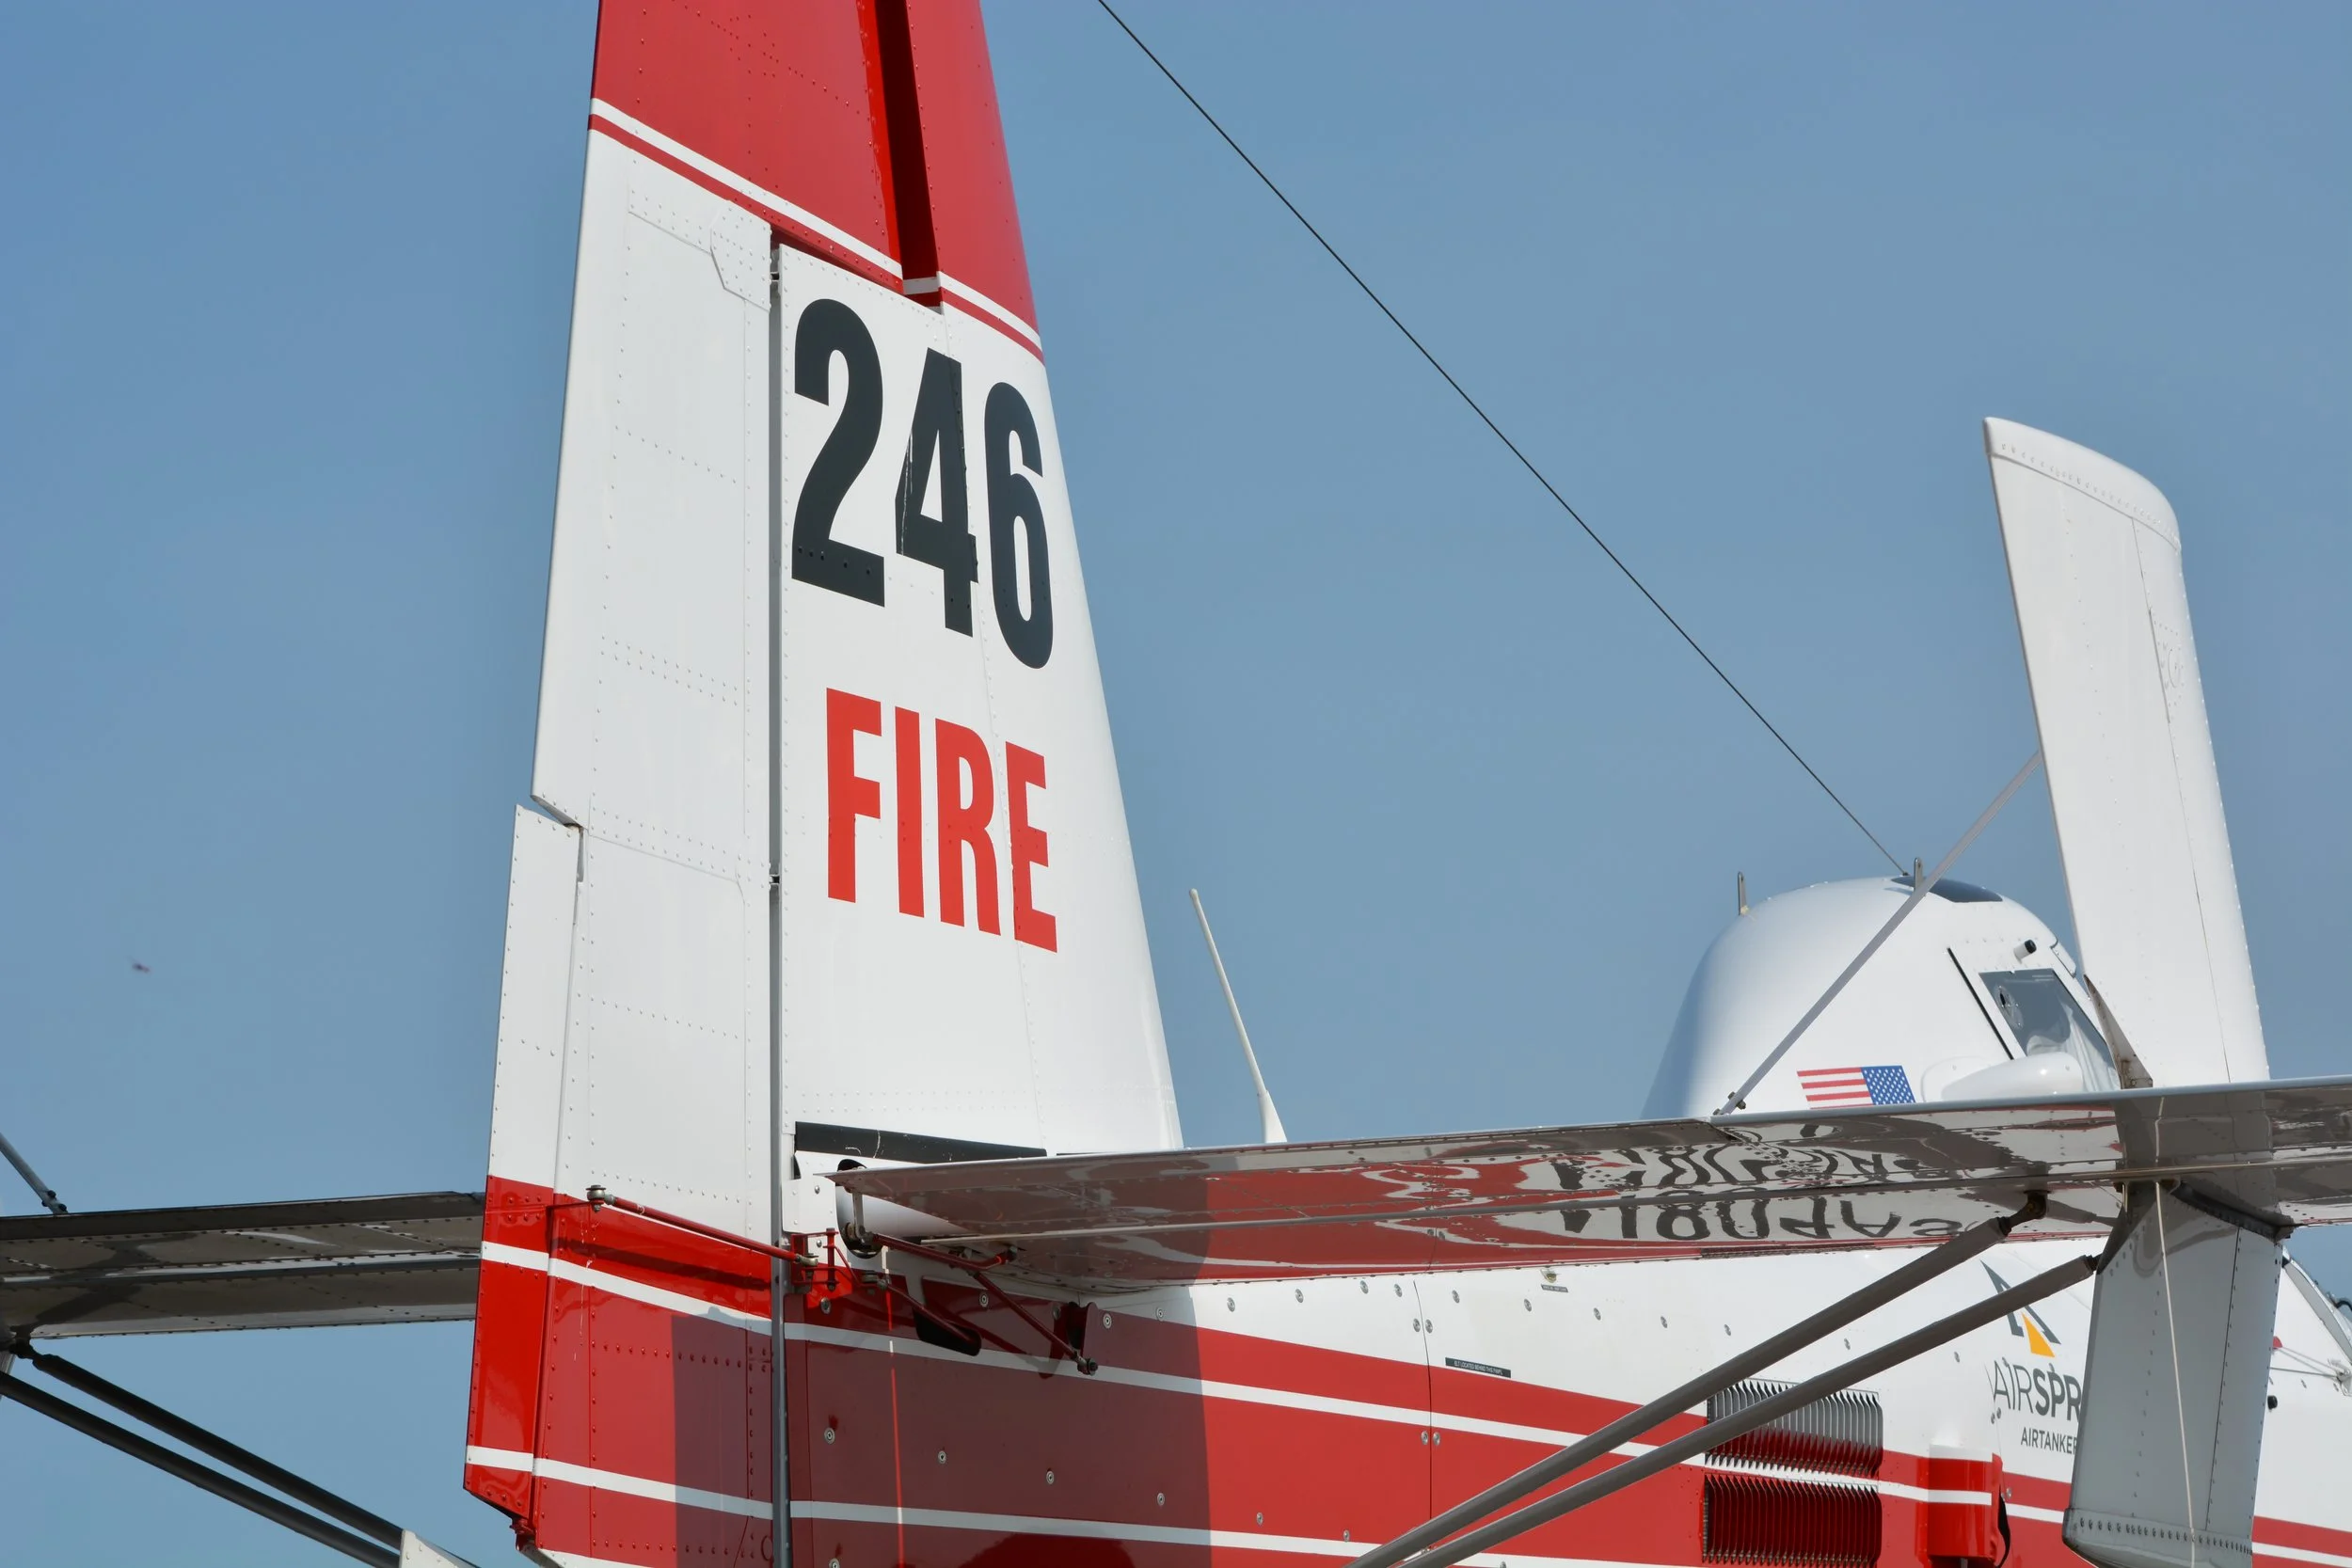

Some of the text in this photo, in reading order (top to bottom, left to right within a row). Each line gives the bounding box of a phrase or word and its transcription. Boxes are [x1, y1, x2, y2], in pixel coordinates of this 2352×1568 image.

[791, 298, 1054, 670] 246
[826, 687, 1057, 953] FIRE
[1994, 1360, 2082, 1422] AIRSPR
